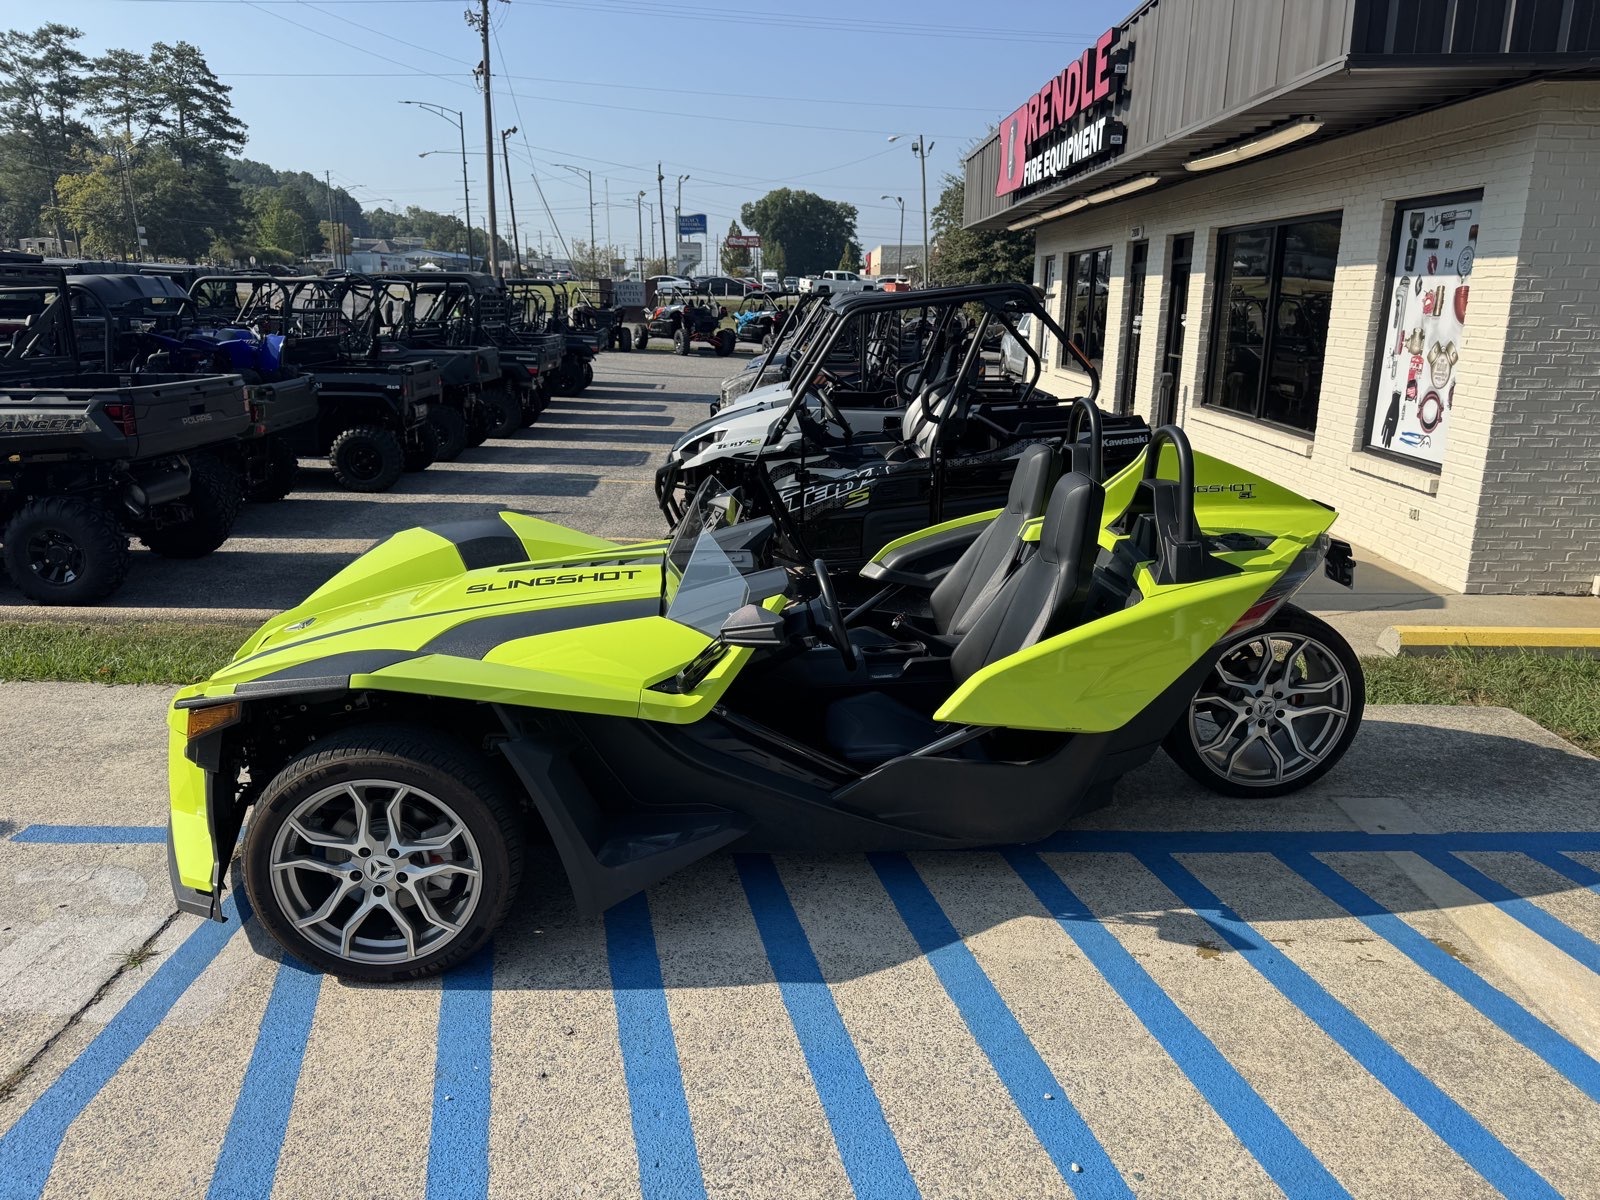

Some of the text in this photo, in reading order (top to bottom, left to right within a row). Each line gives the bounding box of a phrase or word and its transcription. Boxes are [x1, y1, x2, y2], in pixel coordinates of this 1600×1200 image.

[1023, 116, 1107, 187] FIRE EQUIPMENT
[0, 418, 84, 431] ANGER
[182, 412, 213, 425] POLARIS
[1102, 434, 1149, 448] Kawasaki
[1193, 483, 1257, 493] GSHOT
[466, 570, 642, 594] SLINGSHOT
